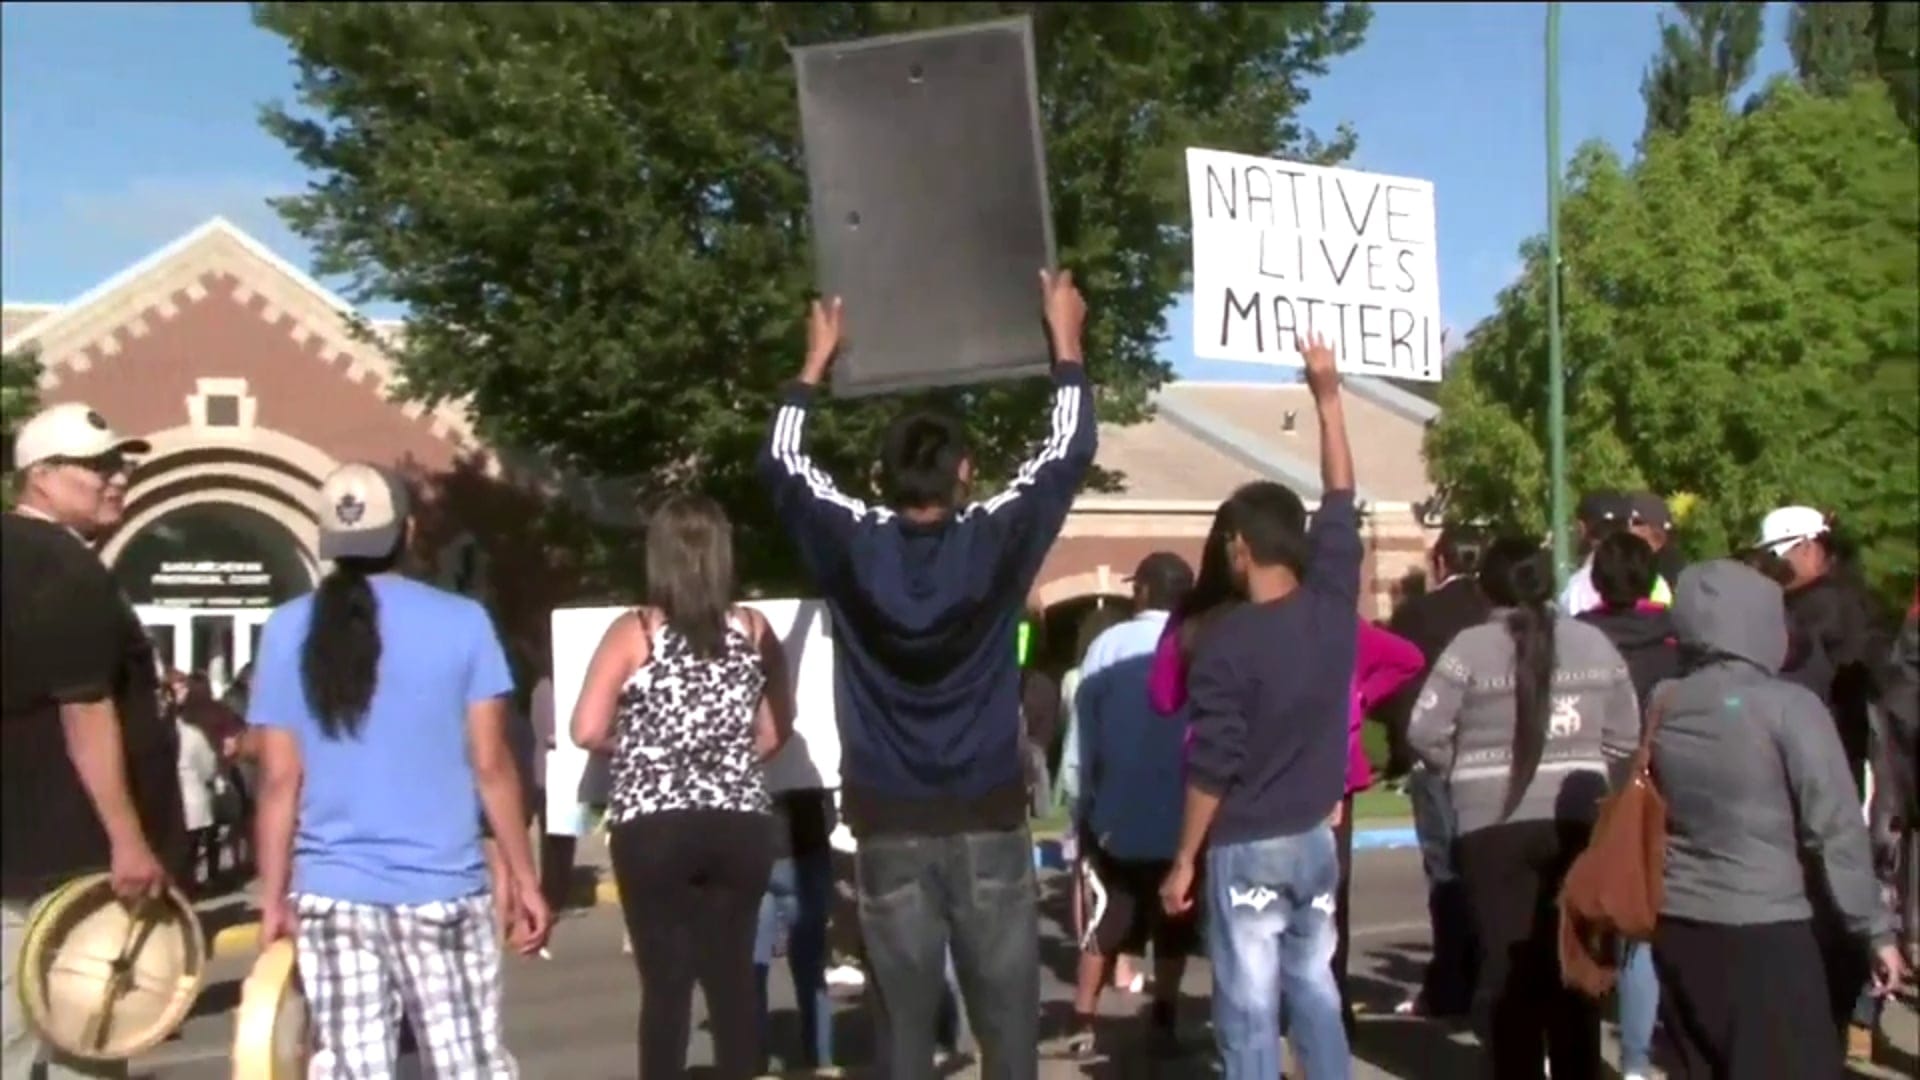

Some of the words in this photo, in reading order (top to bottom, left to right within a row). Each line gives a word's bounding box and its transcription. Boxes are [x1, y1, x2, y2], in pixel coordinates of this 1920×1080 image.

[1207, 164, 1424, 244] NATIVE
[1259, 230, 1415, 293] LIVES
[1220, 287, 1430, 377] MATTER!
